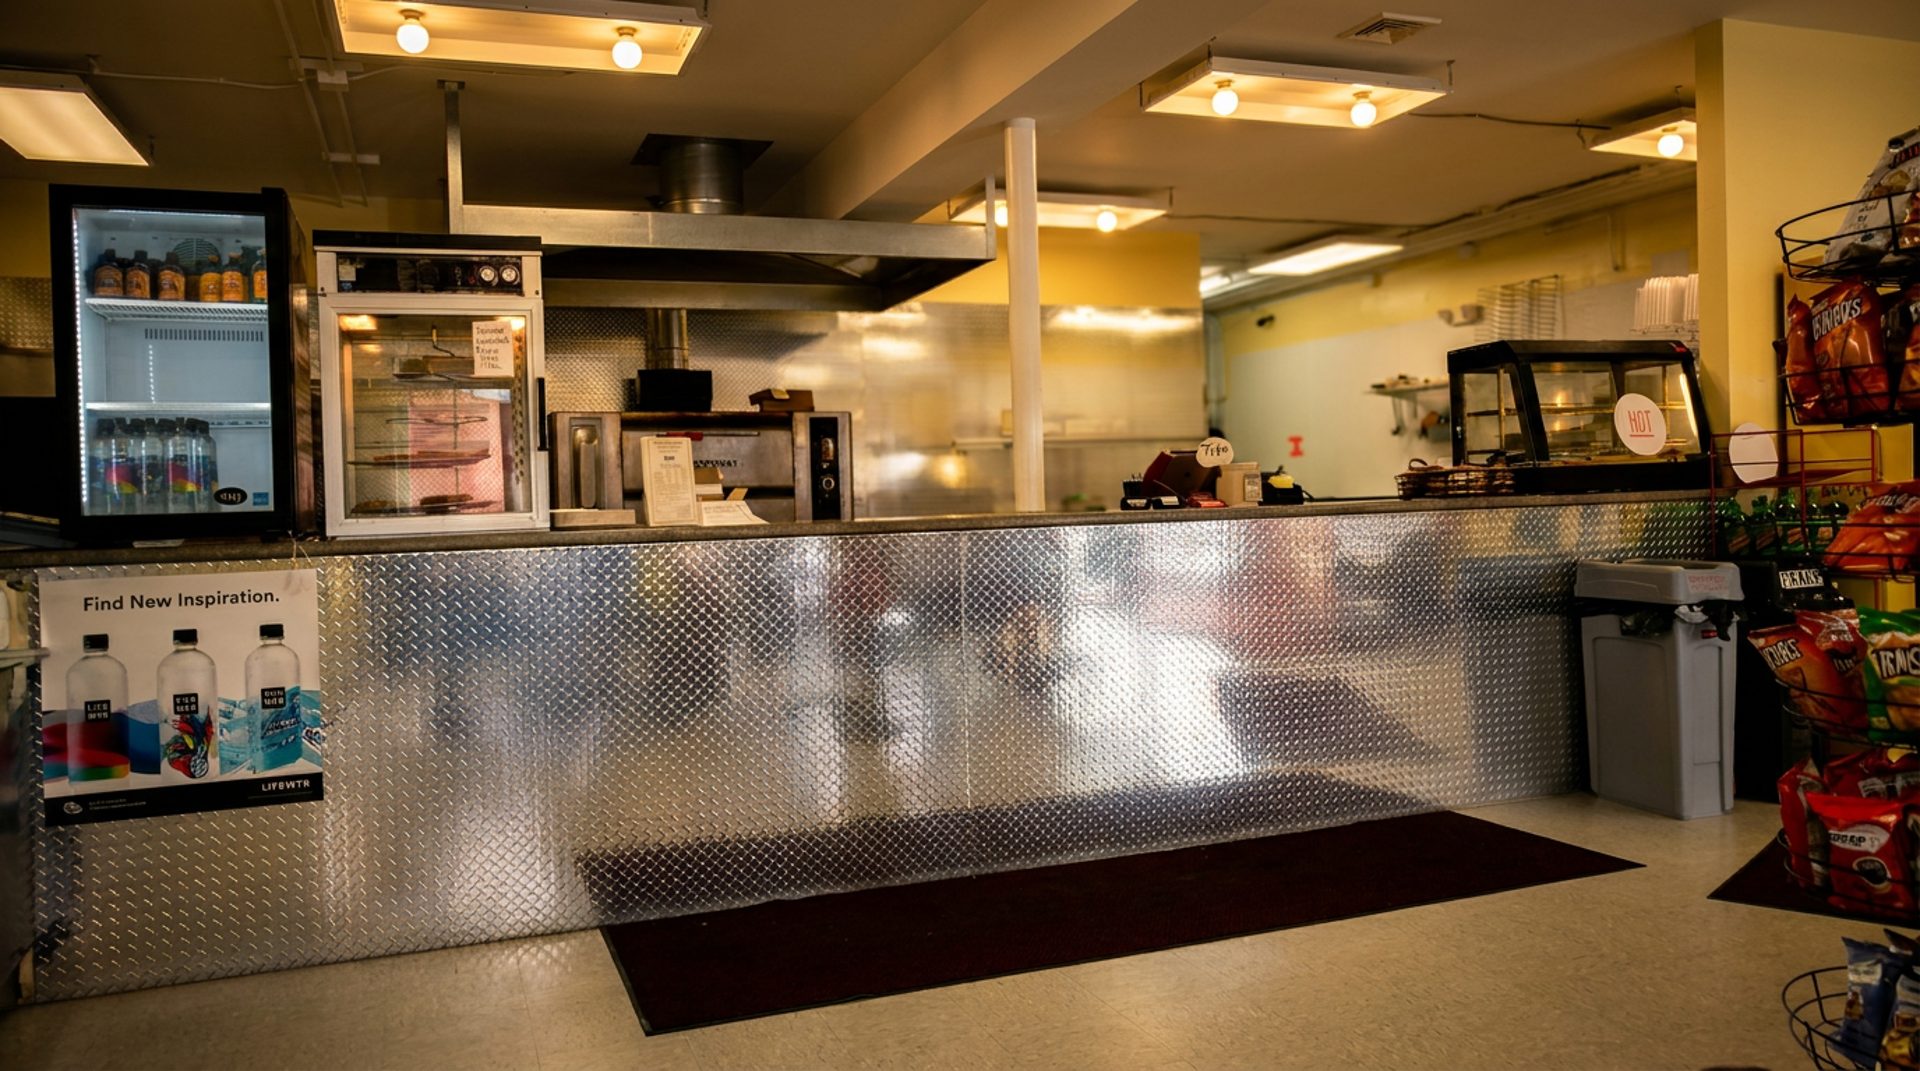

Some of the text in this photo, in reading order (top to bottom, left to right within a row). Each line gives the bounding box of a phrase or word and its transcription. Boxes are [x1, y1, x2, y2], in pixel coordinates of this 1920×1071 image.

[1627, 410, 1652, 433] HOT
[83, 589, 280, 612] Find New Inspiration.
